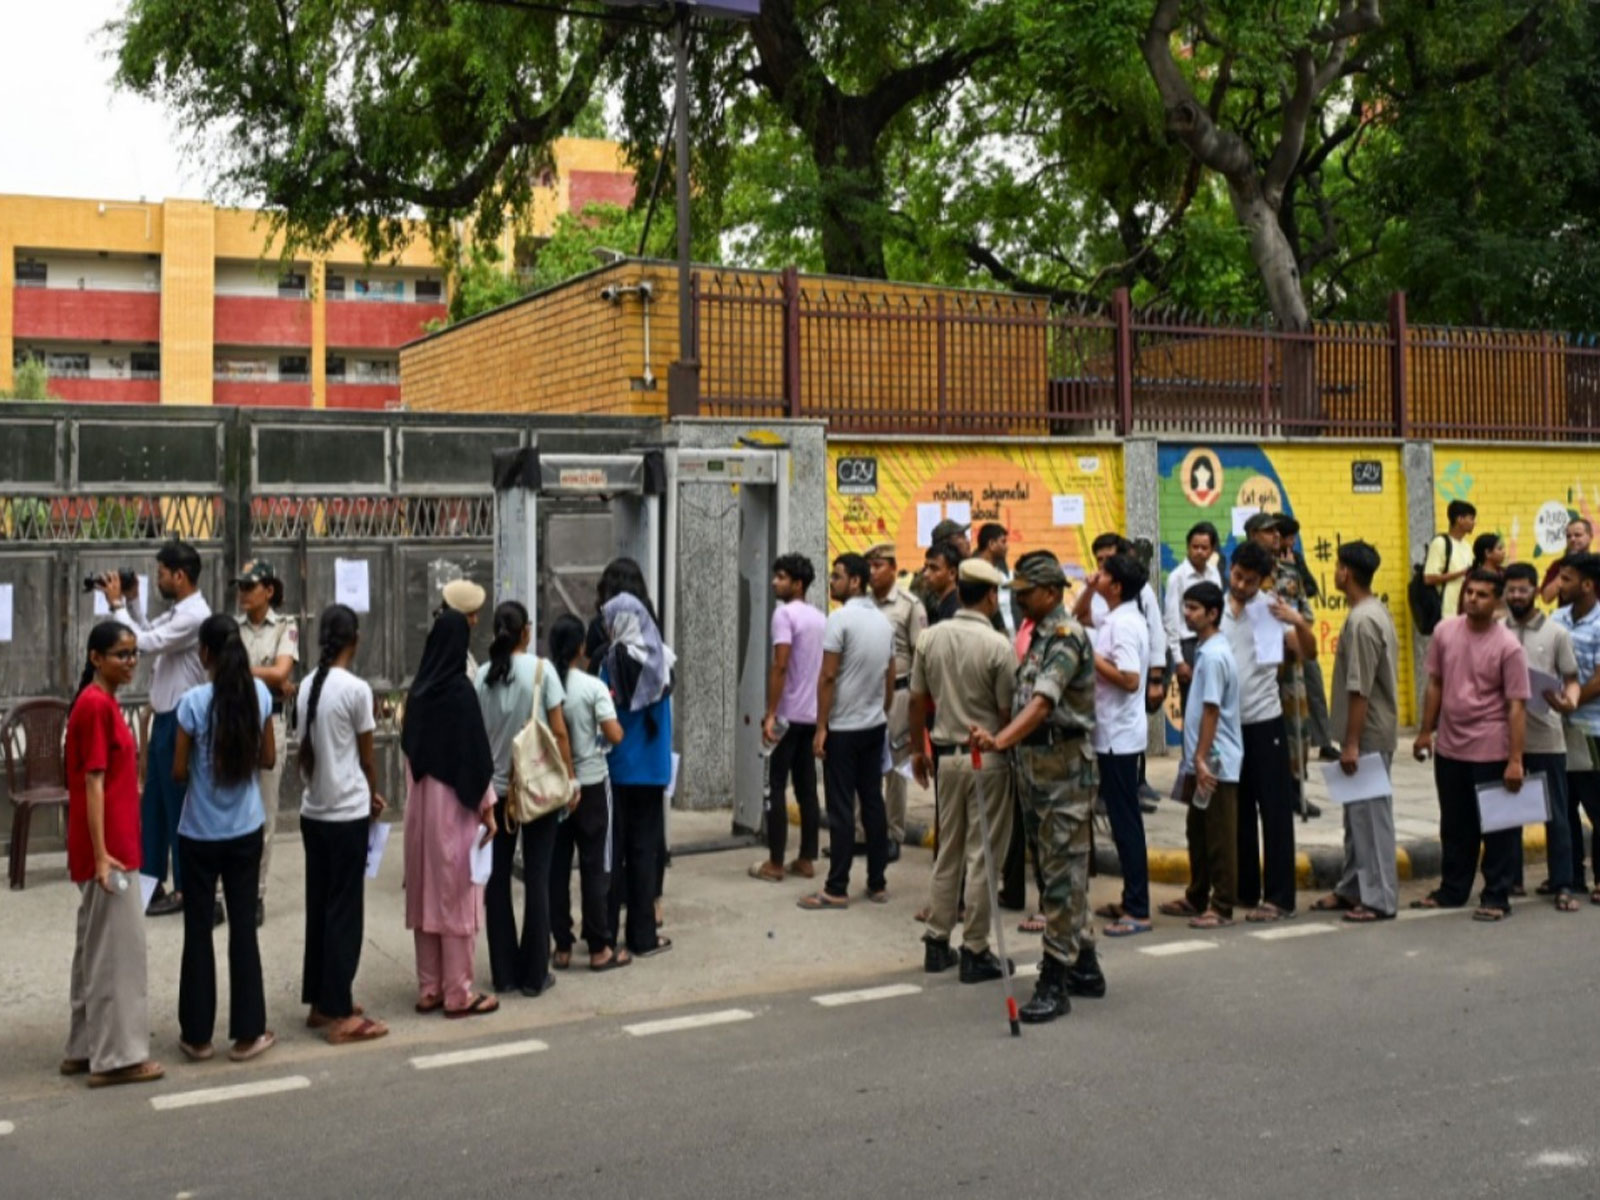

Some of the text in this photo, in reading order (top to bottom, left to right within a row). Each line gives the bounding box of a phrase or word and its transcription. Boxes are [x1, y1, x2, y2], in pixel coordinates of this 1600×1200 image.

[933, 481, 1029, 505] nothing shameful
[972, 500, 1000, 521] about
